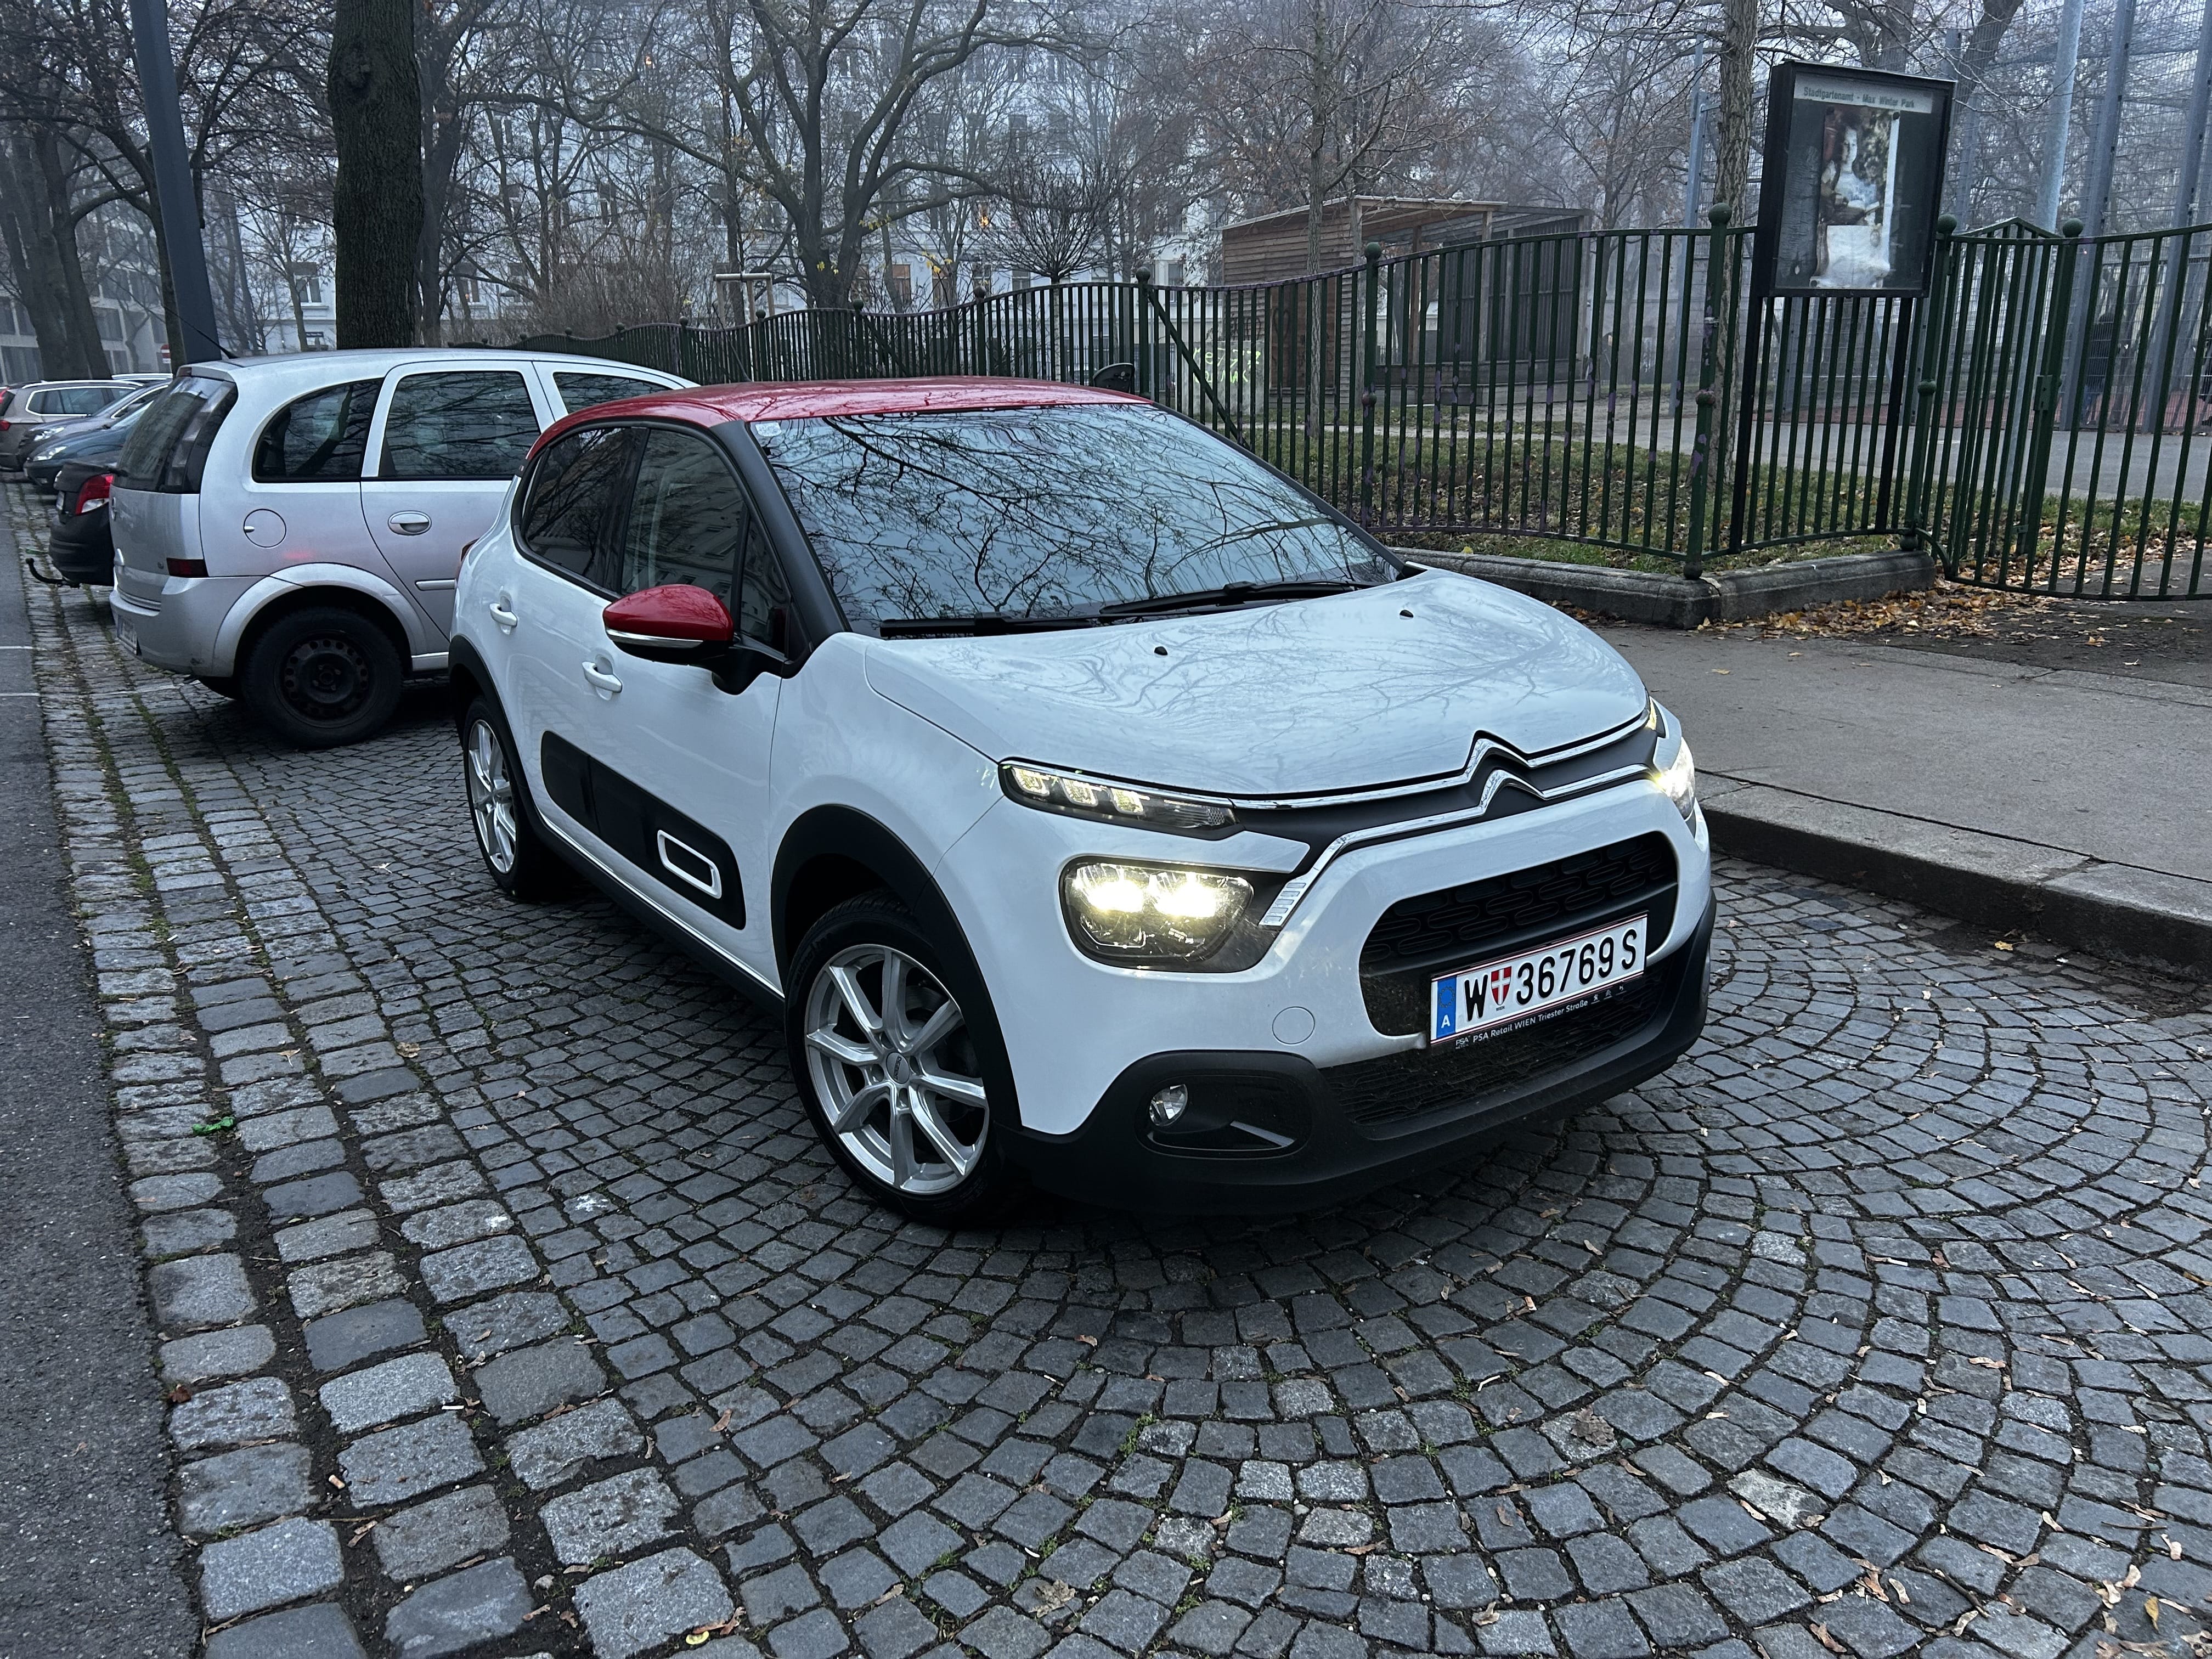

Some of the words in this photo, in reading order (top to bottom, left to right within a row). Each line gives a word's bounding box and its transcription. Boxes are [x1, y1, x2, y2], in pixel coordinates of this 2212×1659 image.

[1803, 86, 1854, 101] Stadtgartenamt
[1863, 94, 1875, 103] Max
[1880, 95, 1898, 106] Winter
[1901, 98, 1914, 108] Park
[1464, 974, 1488, 1022] W
[1516, 936, 1614, 1005] 36769
[1621, 928, 1638, 970] S
[1441, 1014, 1451, 1029] A
[1473, 1032, 1489, 1043] PSA
[1491, 1024, 1513, 1037] Retail
[1514, 1017, 1536, 1029] WIEN
[1538, 1008, 1565, 1022] Triester
[1566, 999, 1588, 1013] Straße
